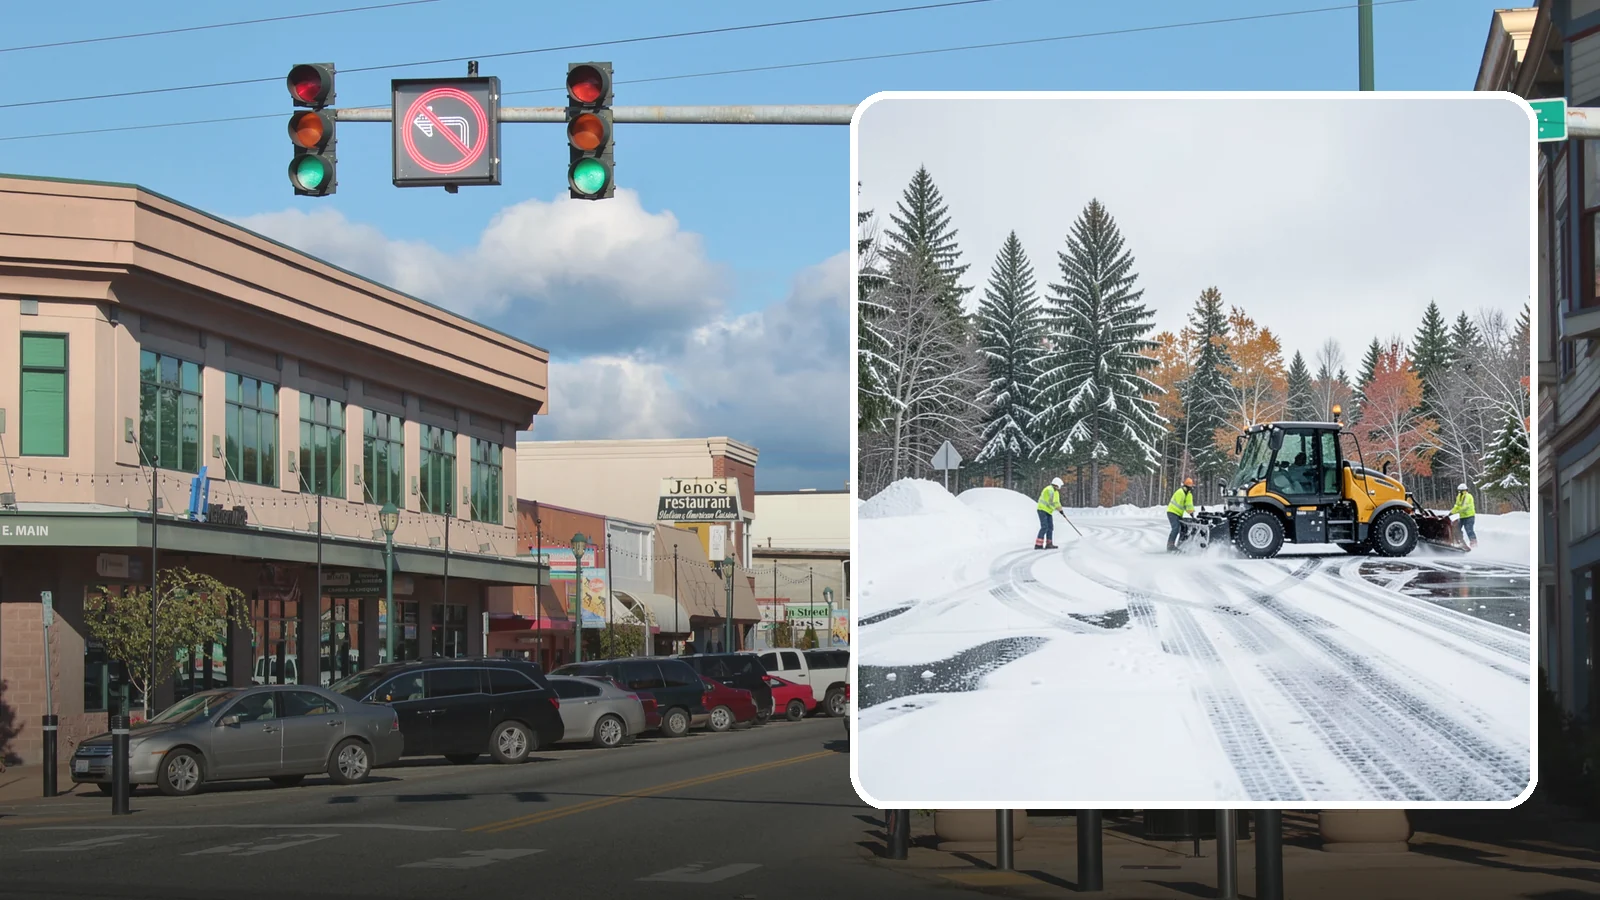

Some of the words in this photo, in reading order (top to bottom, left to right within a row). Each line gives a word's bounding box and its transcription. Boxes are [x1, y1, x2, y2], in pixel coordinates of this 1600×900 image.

[670, 480, 727, 494] Jeno's
[665, 496, 731, 509] restaurant
[659, 510, 681, 519] Italian
[686, 510, 714, 519] American
[715, 510, 737, 519] Cuisine
[2, 525, 13, 536] E.
[15, 525, 49, 536] MAIN
[797, 608, 828, 617] Street
[791, 619, 823, 627] lass
